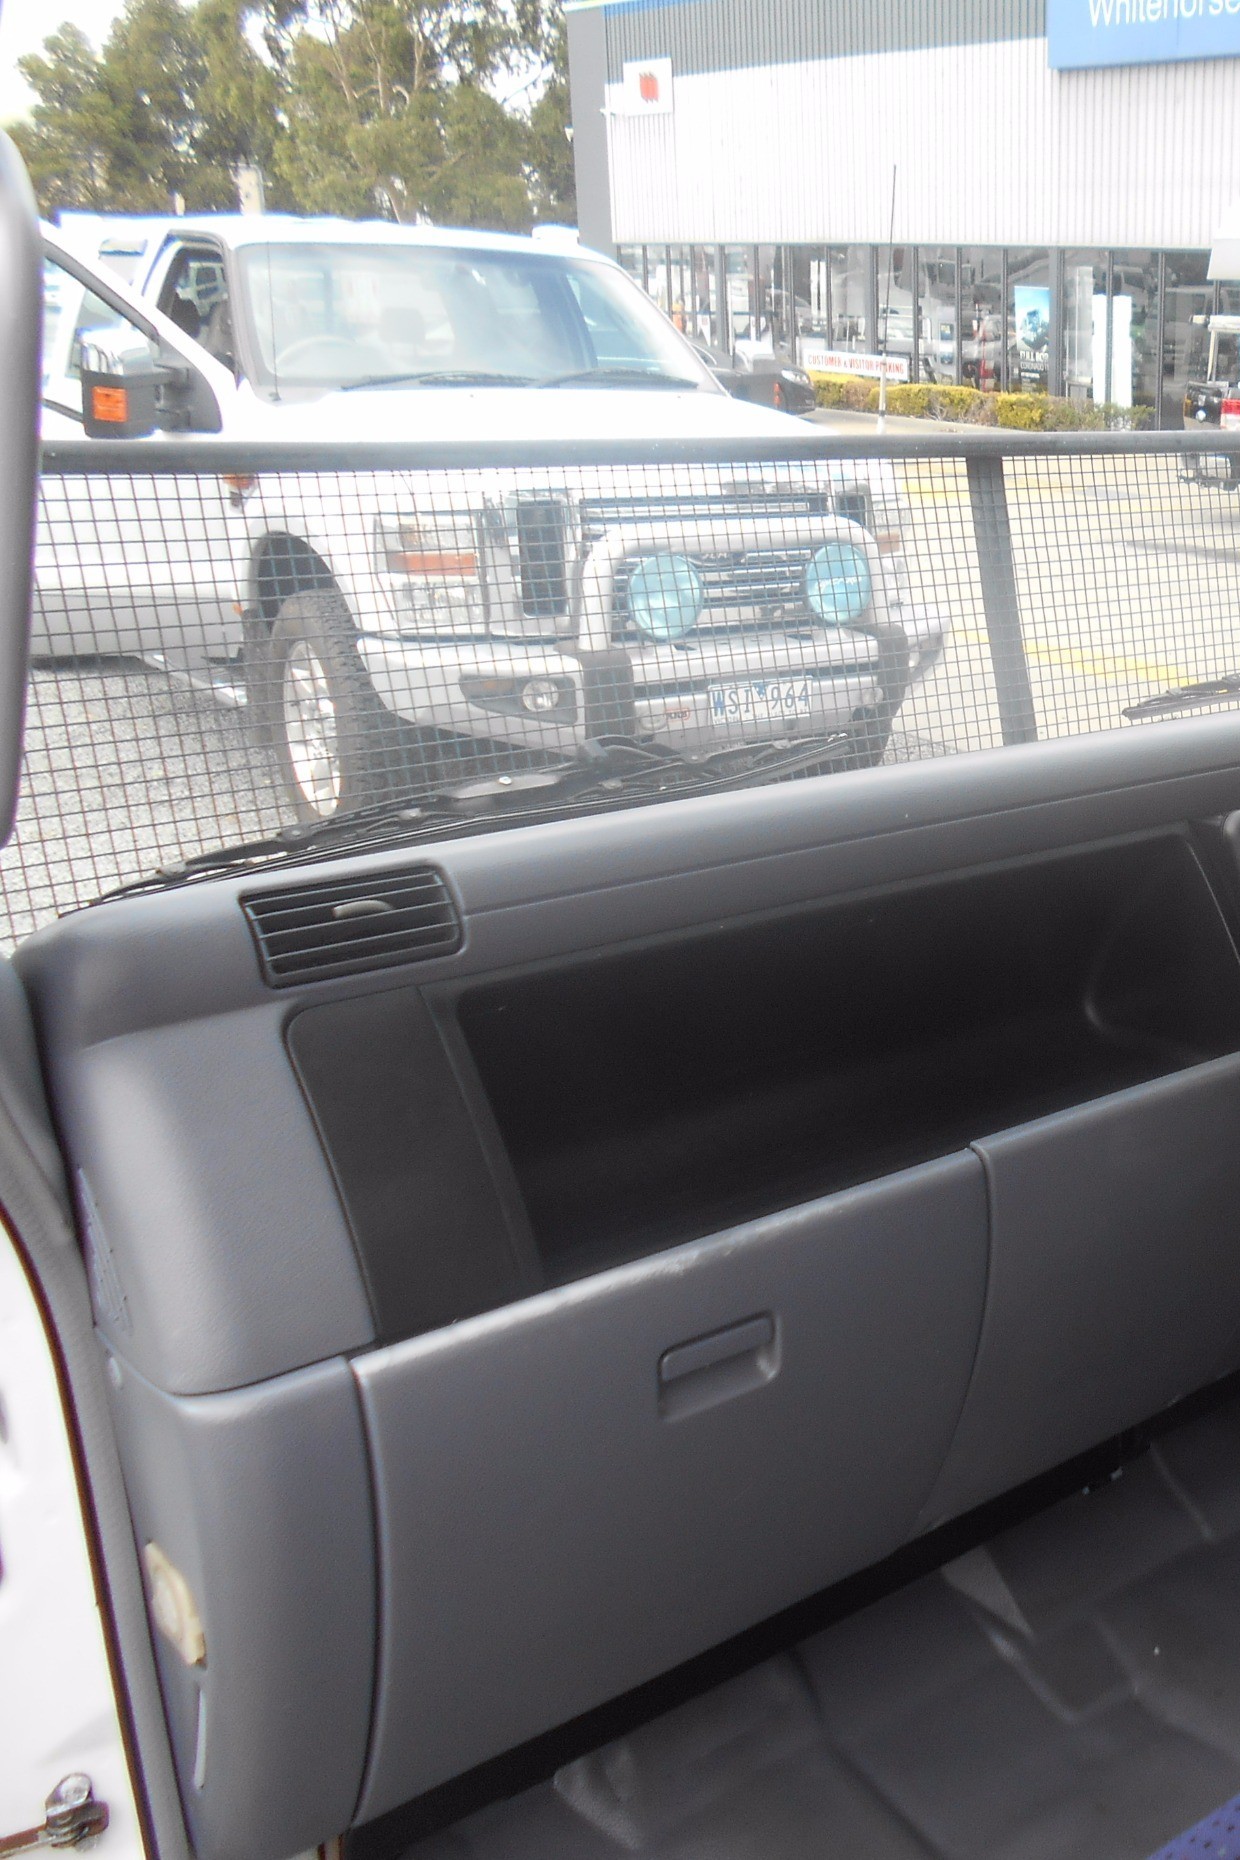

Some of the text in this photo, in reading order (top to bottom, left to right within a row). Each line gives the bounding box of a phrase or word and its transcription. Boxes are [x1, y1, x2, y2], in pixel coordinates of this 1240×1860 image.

[808, 354, 842, 368] CUSTOMER
[849, 357, 874, 371] VISITOR
[875, 360, 904, 374] PAKING
[770, 682, 810, 711] 964
